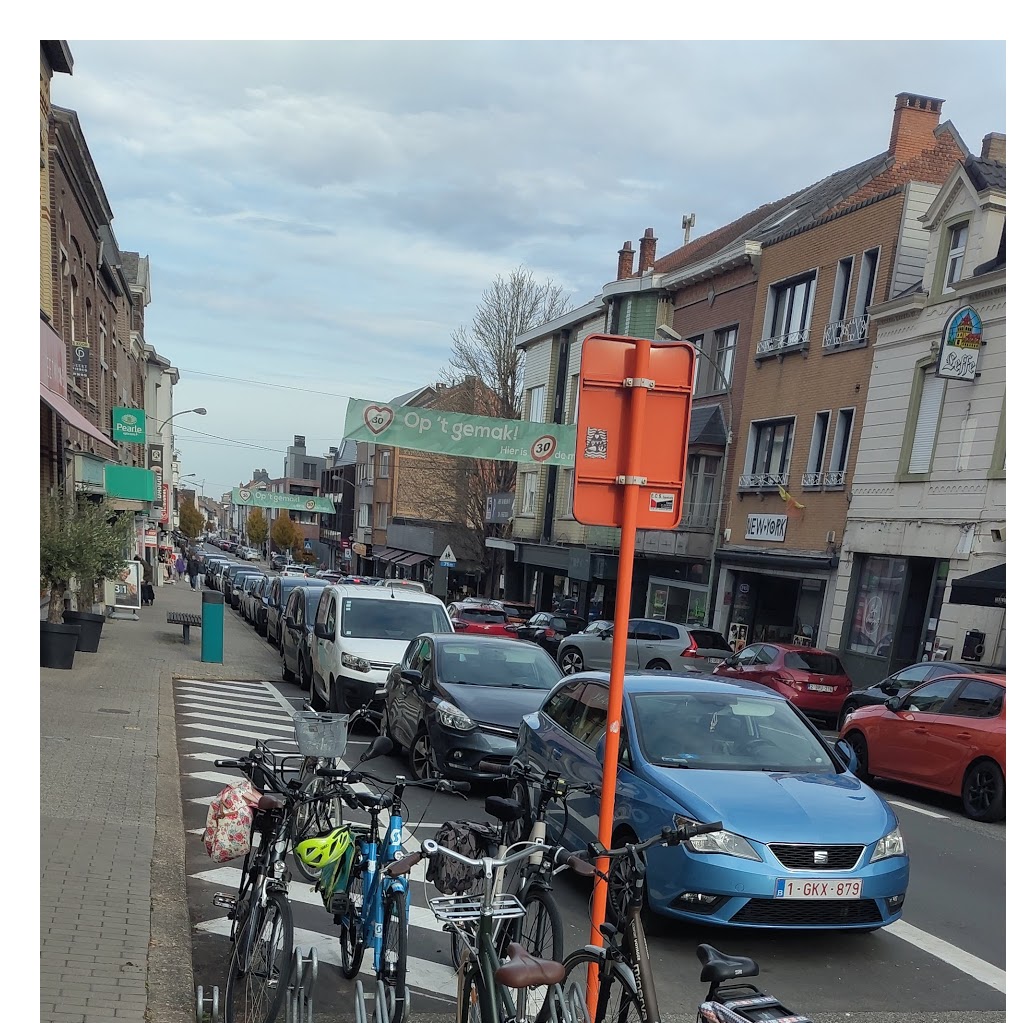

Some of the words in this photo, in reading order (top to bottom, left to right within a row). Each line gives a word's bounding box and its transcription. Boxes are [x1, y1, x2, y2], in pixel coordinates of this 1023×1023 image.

[942, 351, 976, 376] Leffe
[371, 416, 384, 425] 30
[404, 412, 432, 433] Op
[451, 422, 519, 441] gemak!
[116, 422, 142, 434] Pearle
[500, 446, 519, 455] Hier
[535, 442, 551, 454] 30
[787, 882, 860, 896] 1-GKX-879
